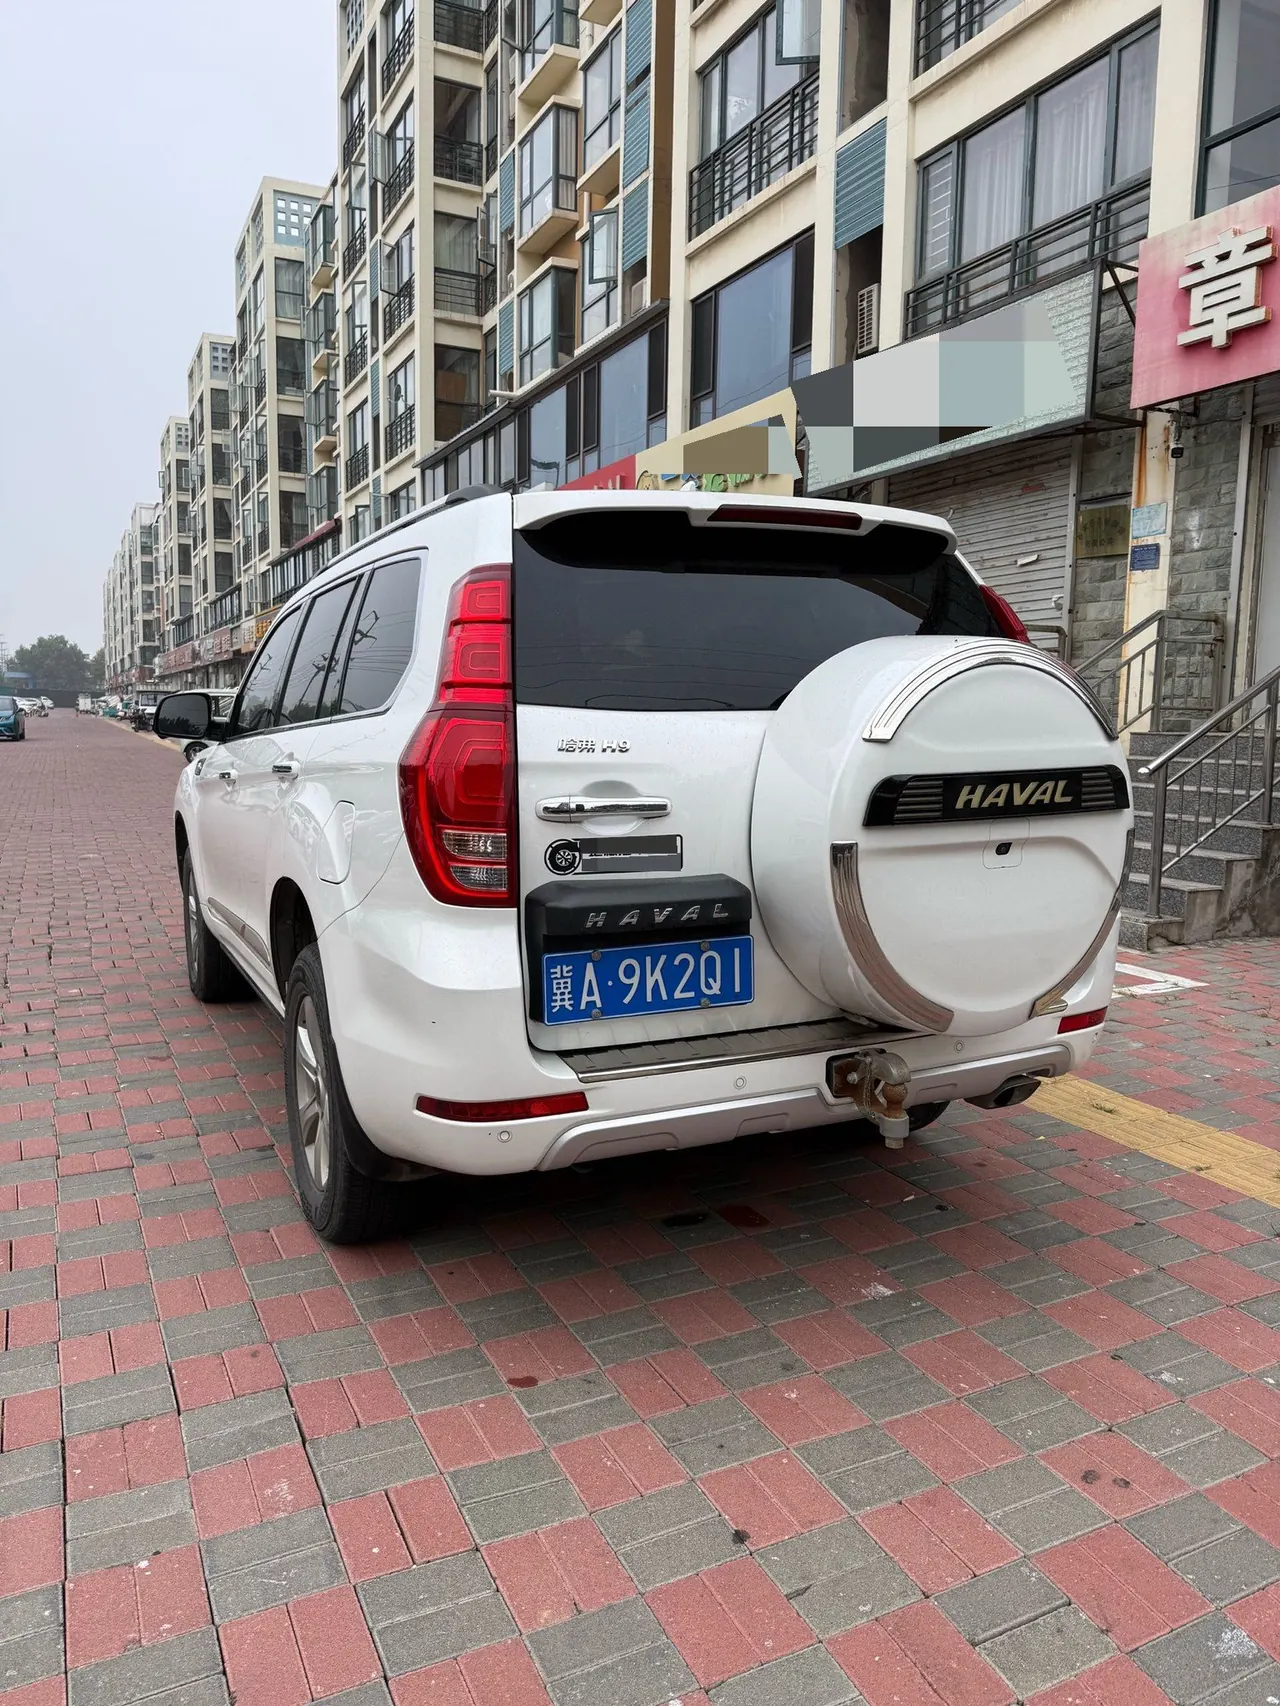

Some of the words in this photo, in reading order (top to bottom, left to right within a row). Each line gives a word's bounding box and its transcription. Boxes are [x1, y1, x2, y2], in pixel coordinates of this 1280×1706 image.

[1177, 225, 1279, 348] 章
[557, 738, 596, 753] 哈弗
[601, 739, 632, 753] H9
[955, 780, 1074, 809] HAVAL
[585, 903, 729, 928] HAVAL
